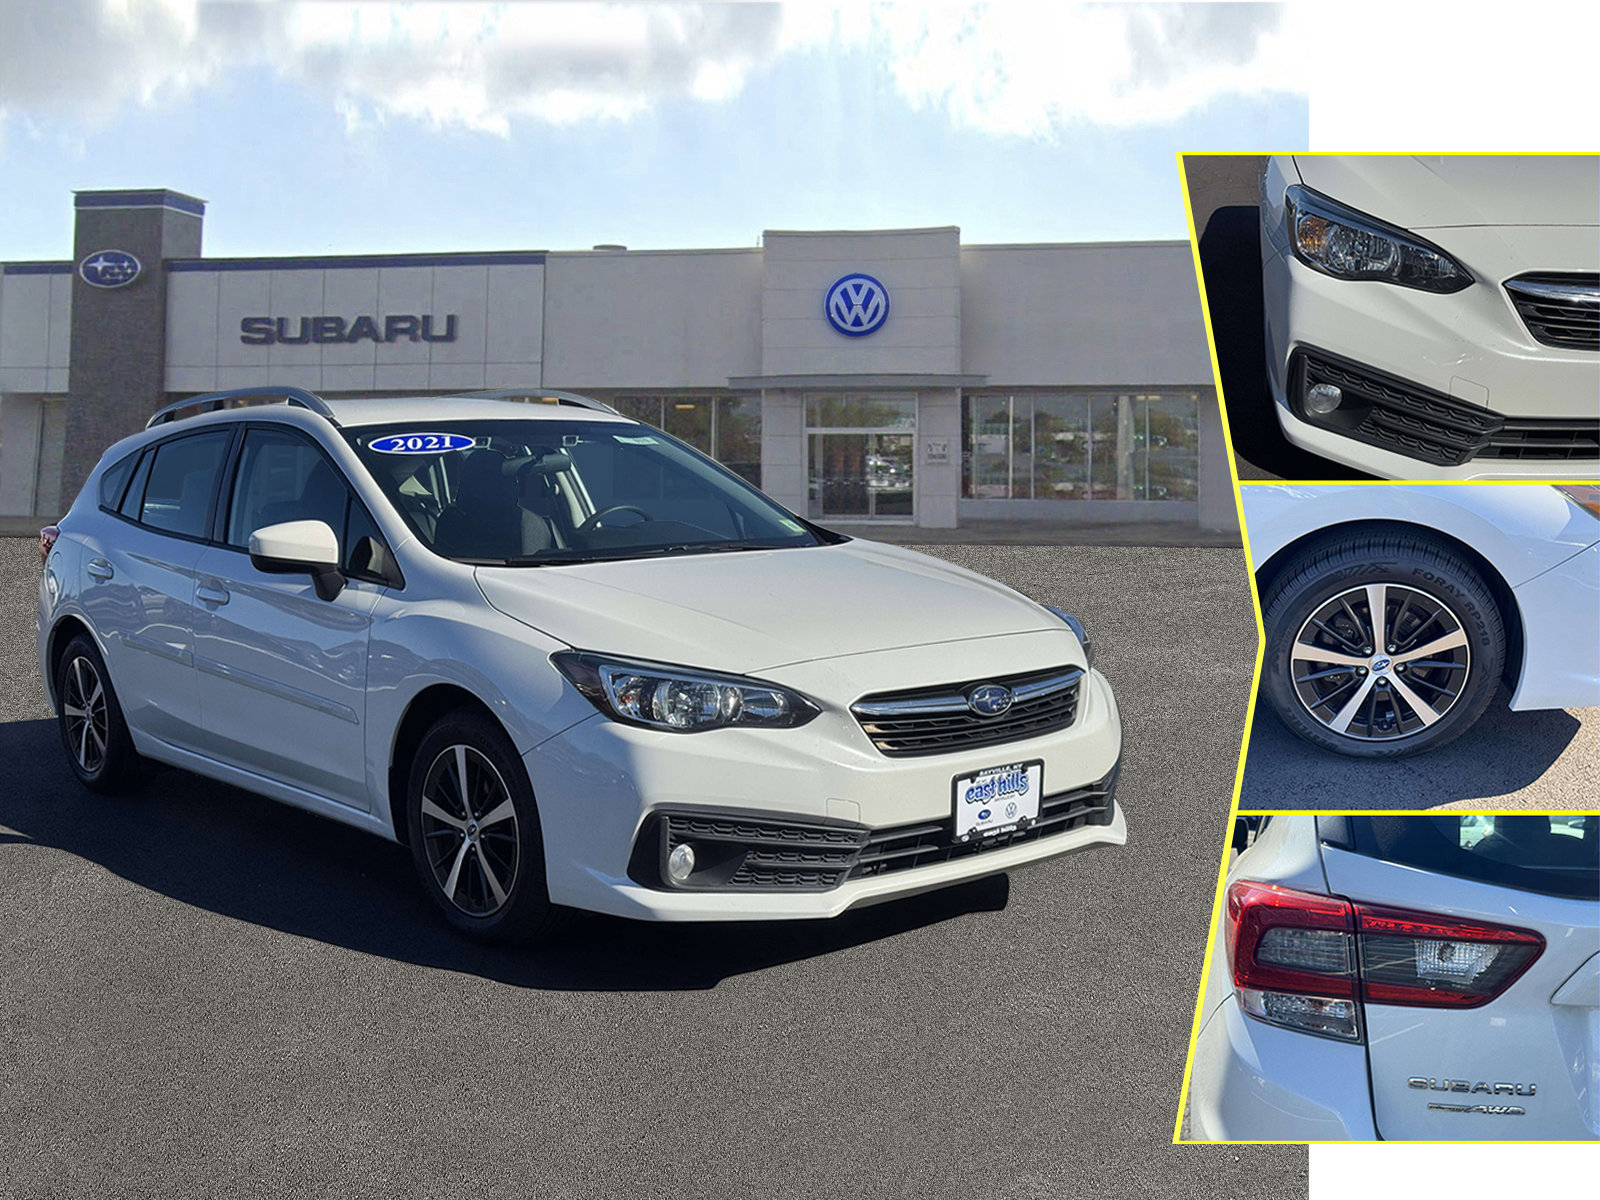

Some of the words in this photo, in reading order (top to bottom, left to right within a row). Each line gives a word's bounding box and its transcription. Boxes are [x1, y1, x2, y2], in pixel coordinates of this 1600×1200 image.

[239, 314, 459, 345] SUBARU
[390, 436, 454, 451] 2021
[1412, 567, 1465, 598] FORAY
[965, 776, 996, 804] east
[998, 771, 1030, 797] hills
[1408, 1076, 1537, 1097] SUBARU
[1465, 1104, 1526, 1116] AWD
